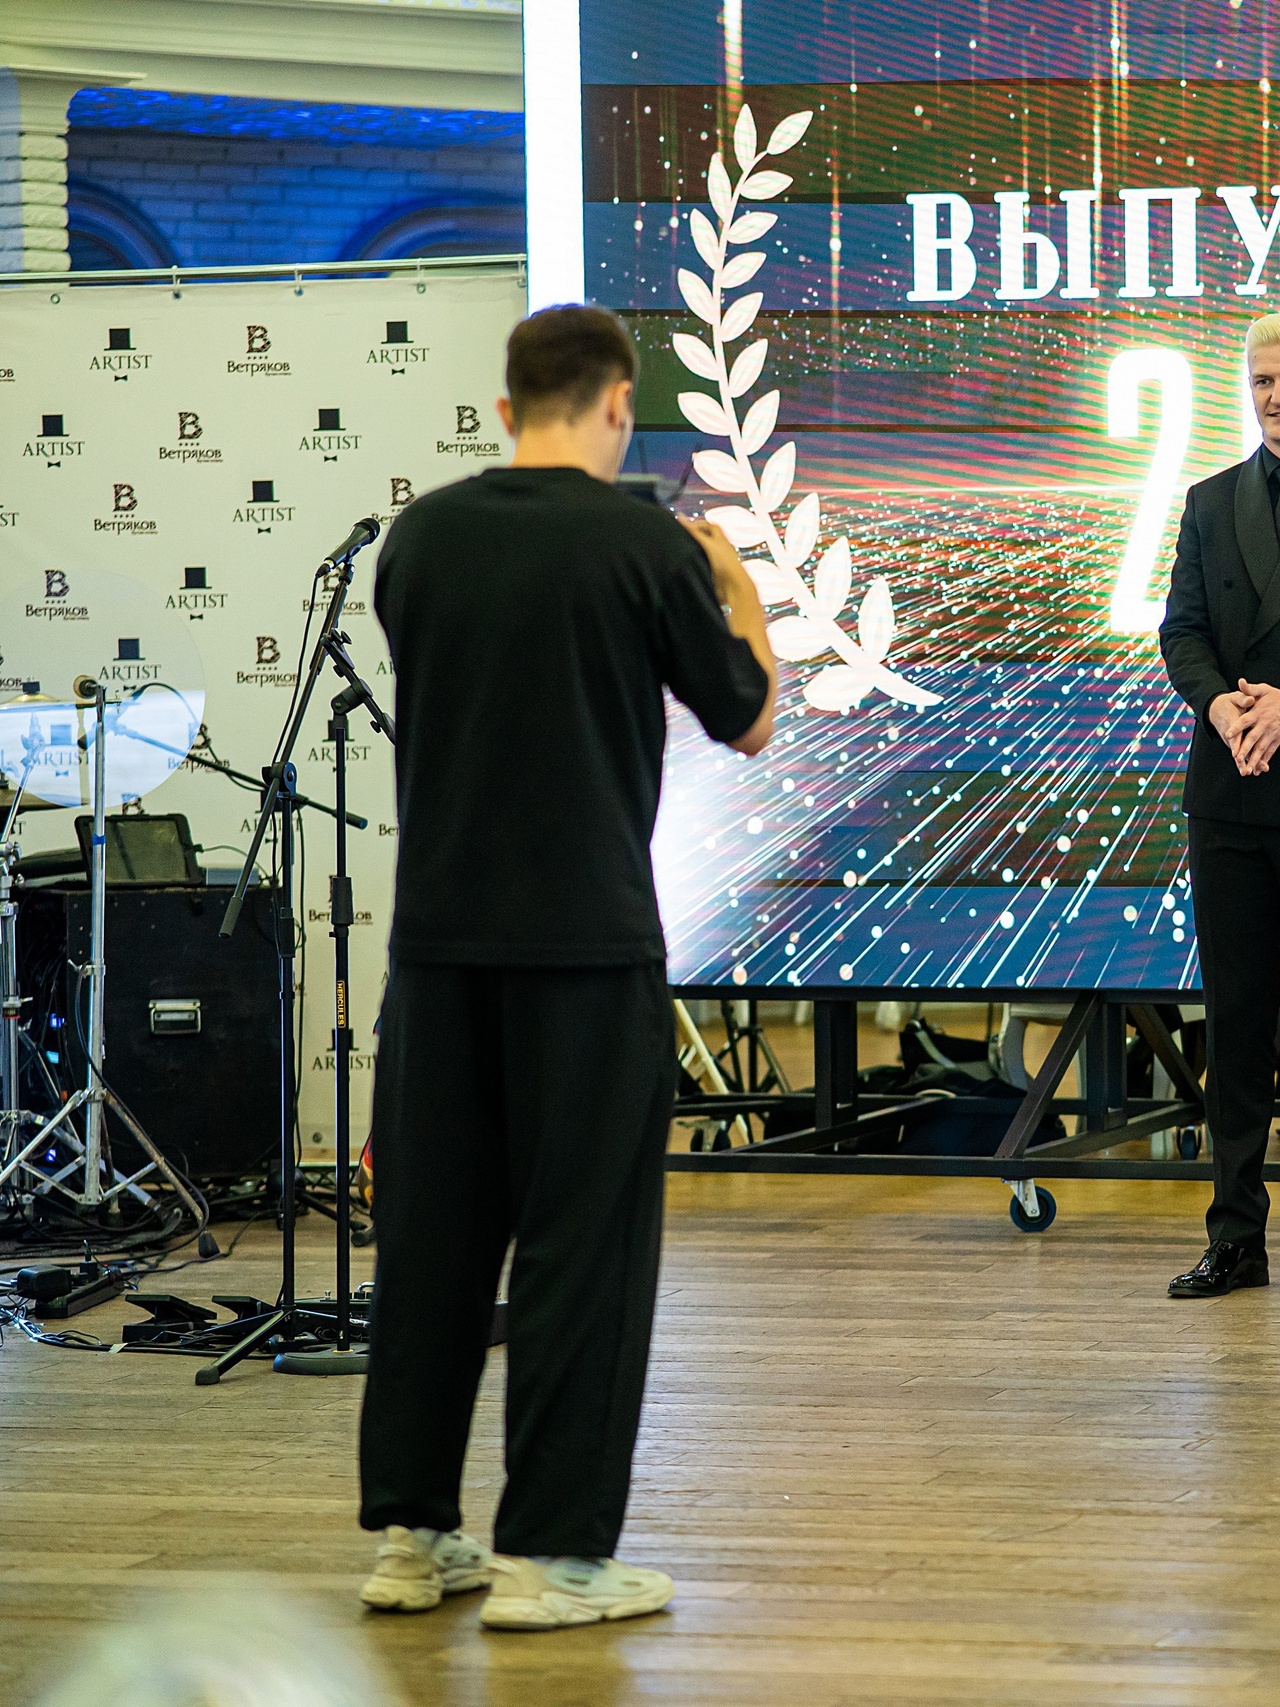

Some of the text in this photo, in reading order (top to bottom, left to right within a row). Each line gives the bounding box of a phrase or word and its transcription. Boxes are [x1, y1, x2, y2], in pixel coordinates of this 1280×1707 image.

[90, 355, 153, 370] ARTIST
[366, 348, 430, 364] ARTIST
[227, 360, 291, 376] Ветряков
[23, 441, 86, 457] ARTIST
[299, 435, 362, 451] ARTIST
[437, 441, 500, 456] Ветряков
[159, 447, 222, 463] Ветряков
[233, 507, 296, 523] ARTIST
[94, 518, 157, 535] Ветряков
[165, 594, 229, 610] ARTIST
[25, 604, 89, 621] Ветряков
[98, 664, 163, 680] ARTIST
[308, 745, 371, 762] ARIST
[337, 982, 345, 1025] HERCULES
[312, 1054, 378, 1070] ARIST
